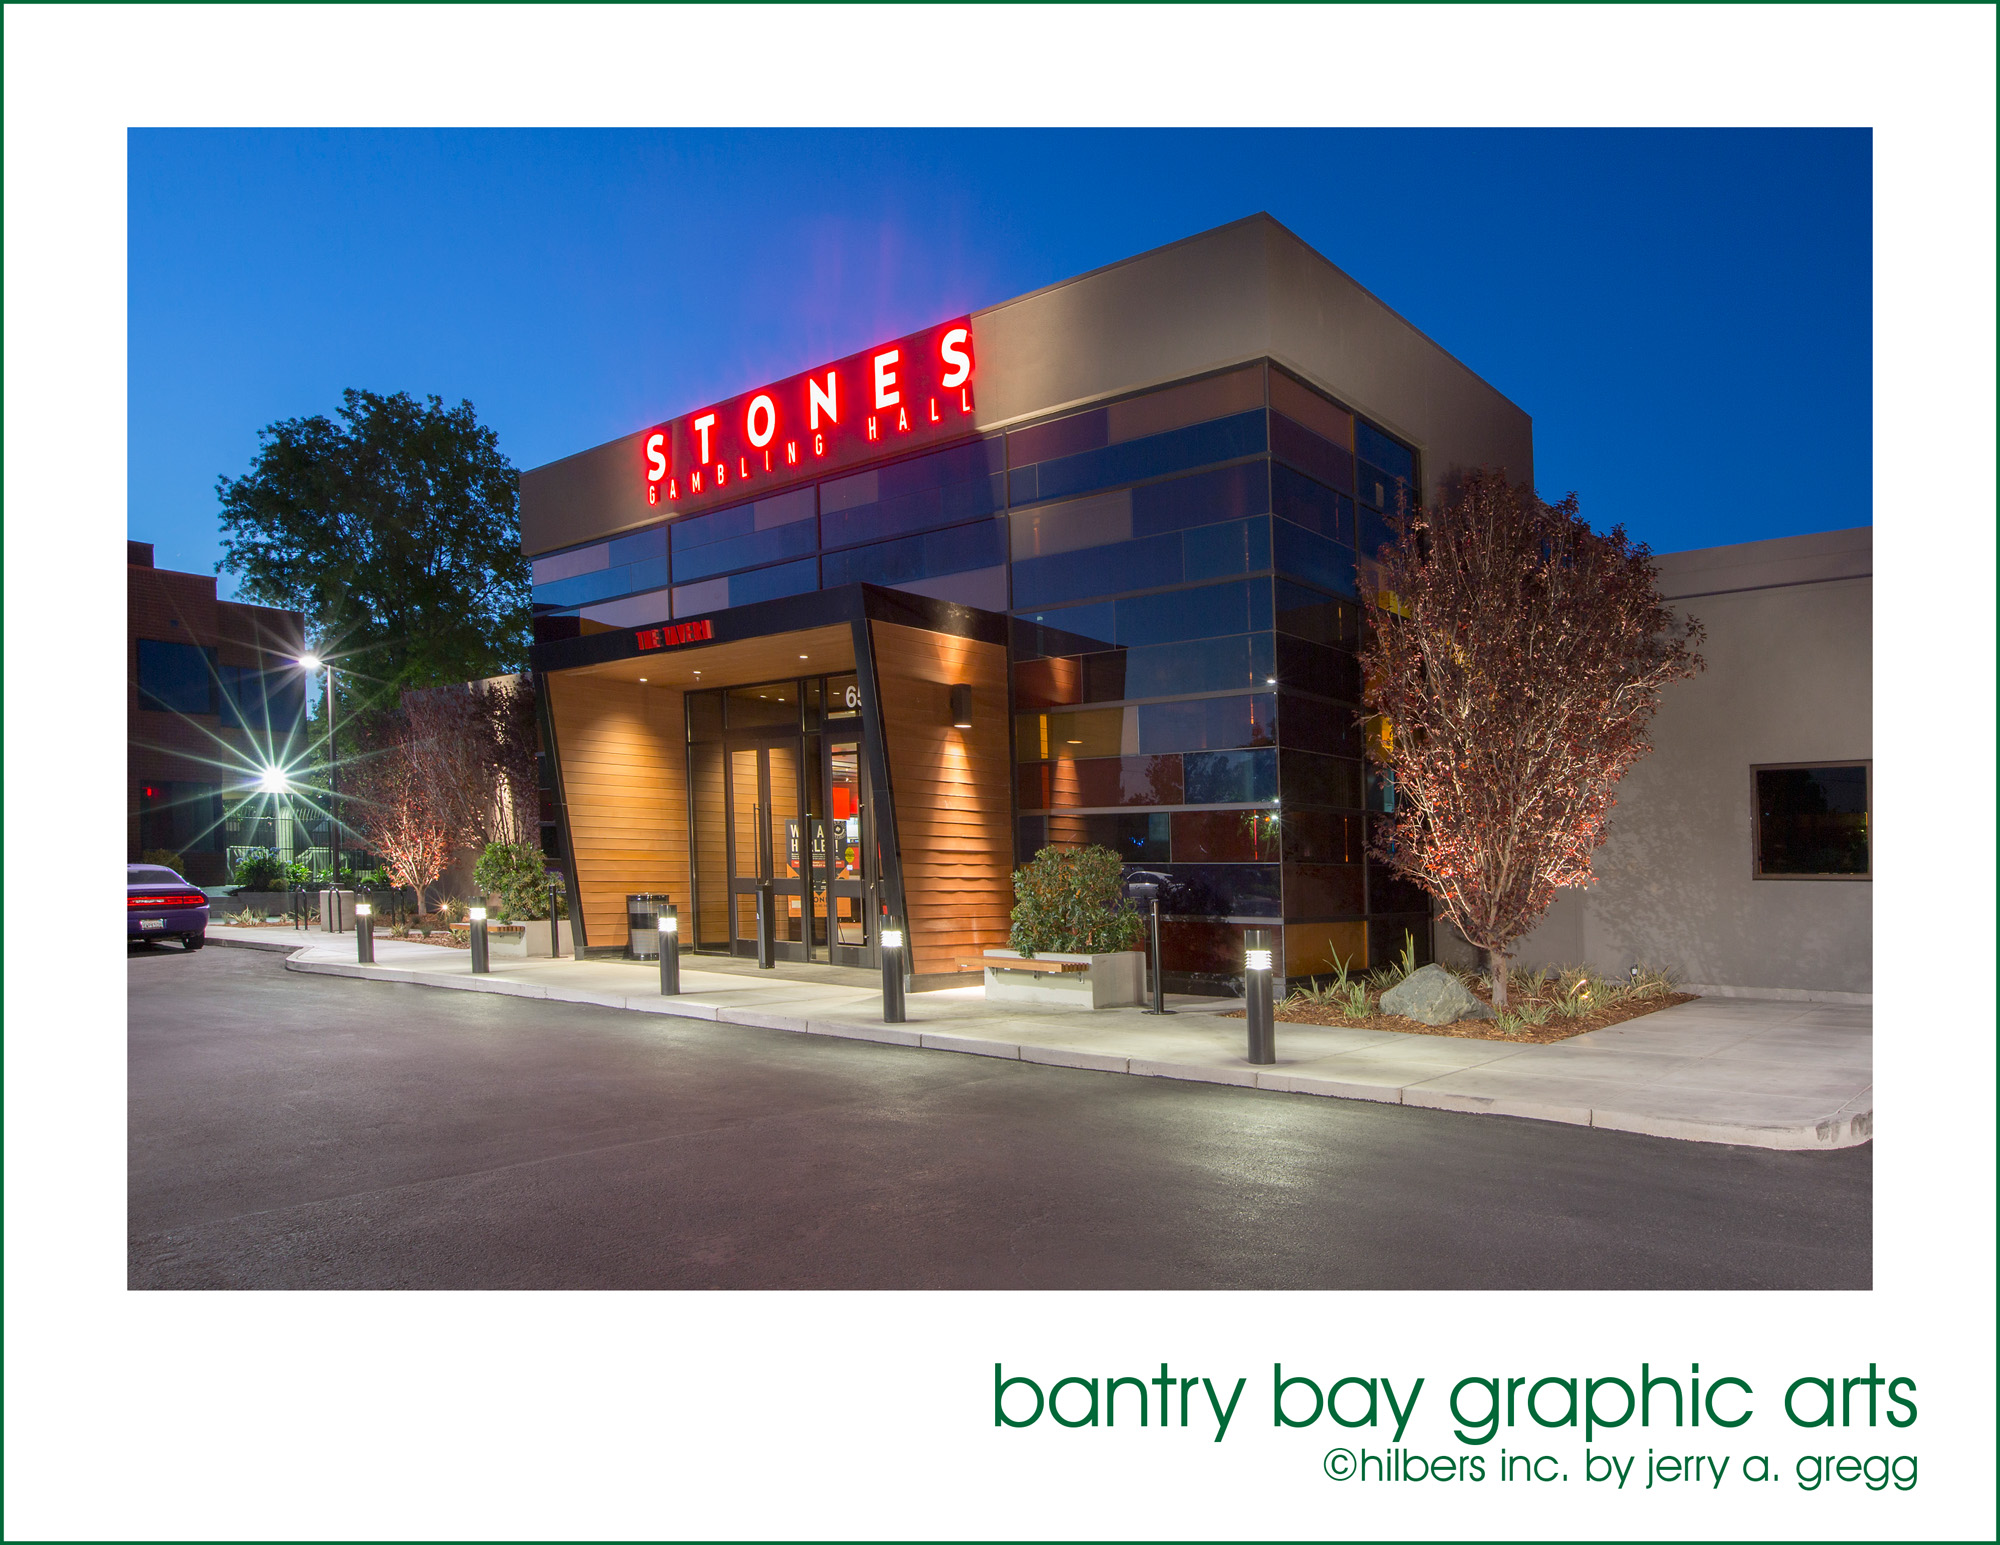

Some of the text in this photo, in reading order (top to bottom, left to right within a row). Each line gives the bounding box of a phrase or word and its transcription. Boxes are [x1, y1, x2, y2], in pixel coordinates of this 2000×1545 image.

[646, 328, 971, 482] STONES
[648, 387, 972, 505] GAMBLING HALL
[635, 629, 661, 650] THE
